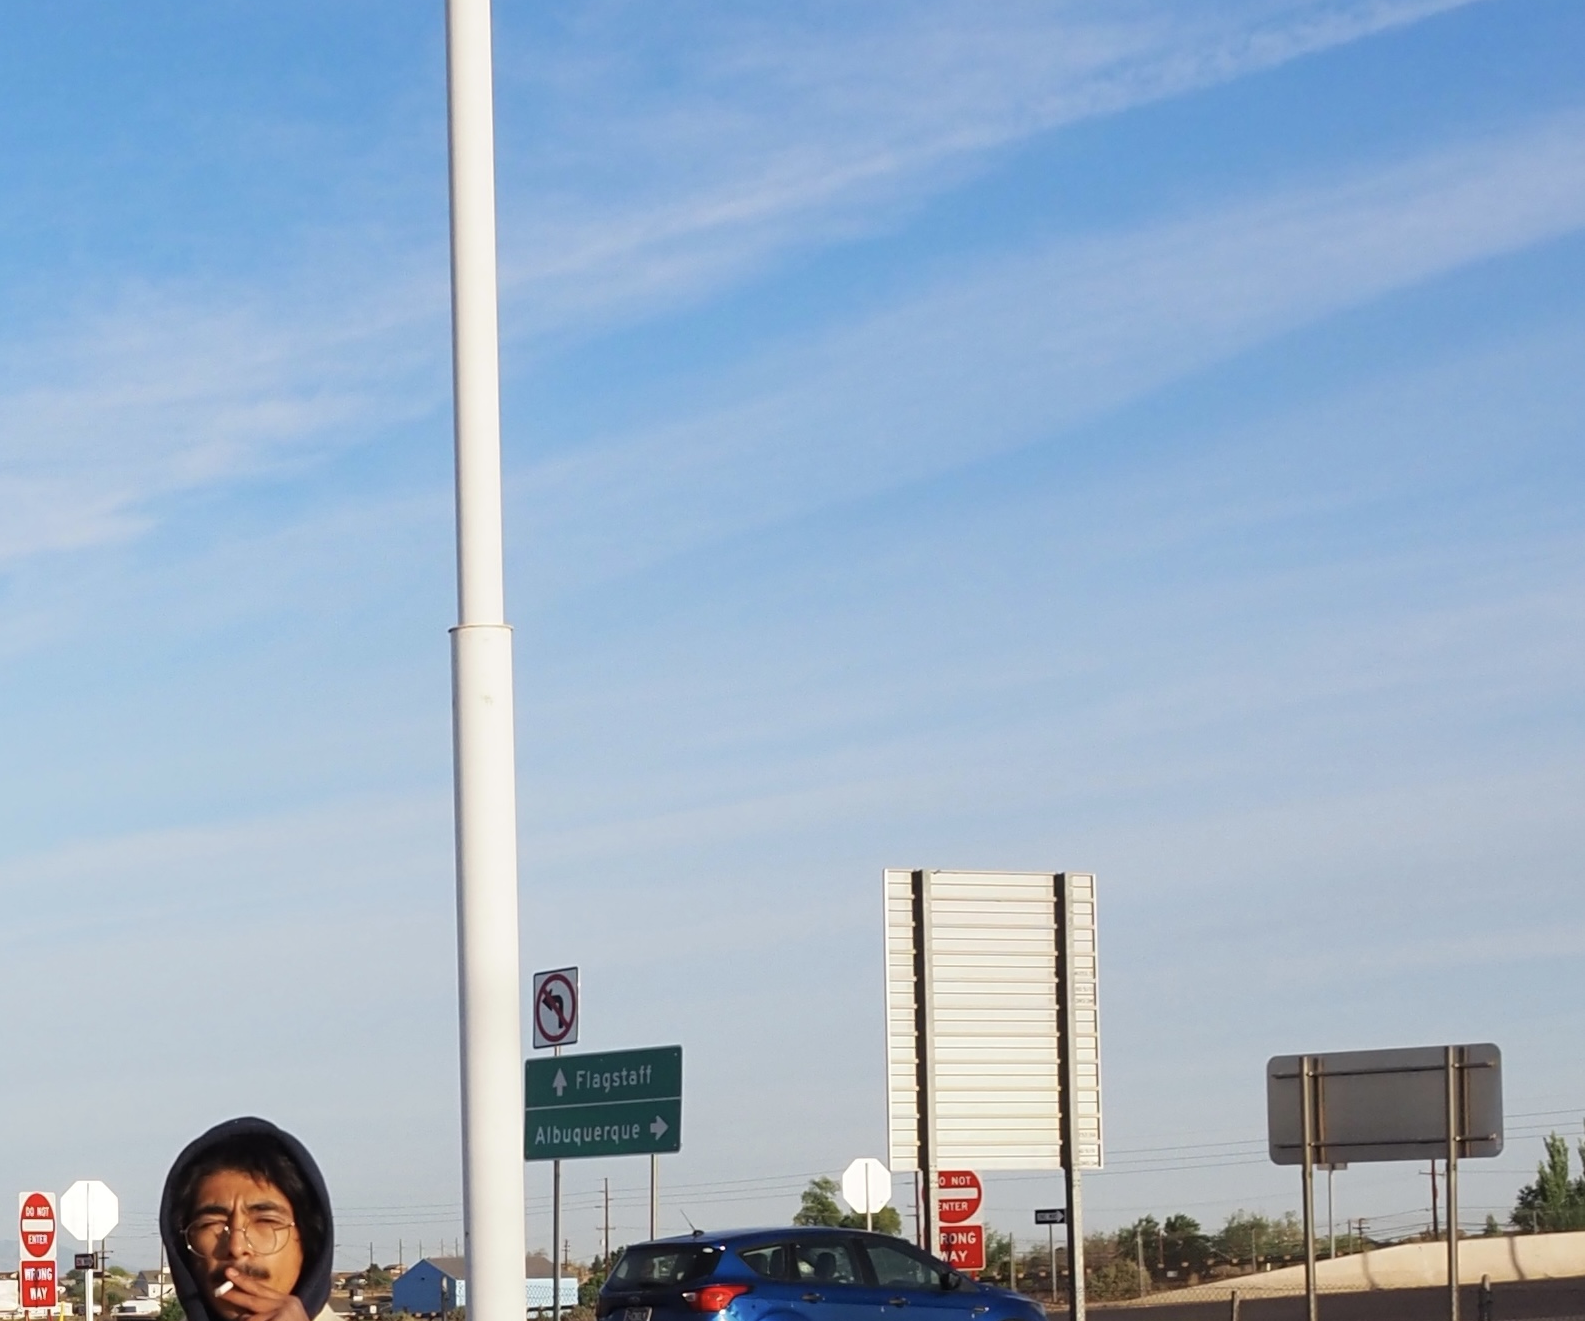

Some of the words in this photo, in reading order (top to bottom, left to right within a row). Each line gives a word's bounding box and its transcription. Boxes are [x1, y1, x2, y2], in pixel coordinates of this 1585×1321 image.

[576, 1065, 652, 1093] Flagstaff
[534, 1123, 640, 1146] Albuquerque
[951, 1176, 971, 1186] NOT
[25, 1206, 35, 1217] DO
[37, 1206, 50, 1217] NOT
[27, 1234, 48, 1245] ENTER
[940, 1232, 976, 1244] RONG
[24, 1267, 53, 1281] WRONG
[29, 1286, 48, 1300] WAY
